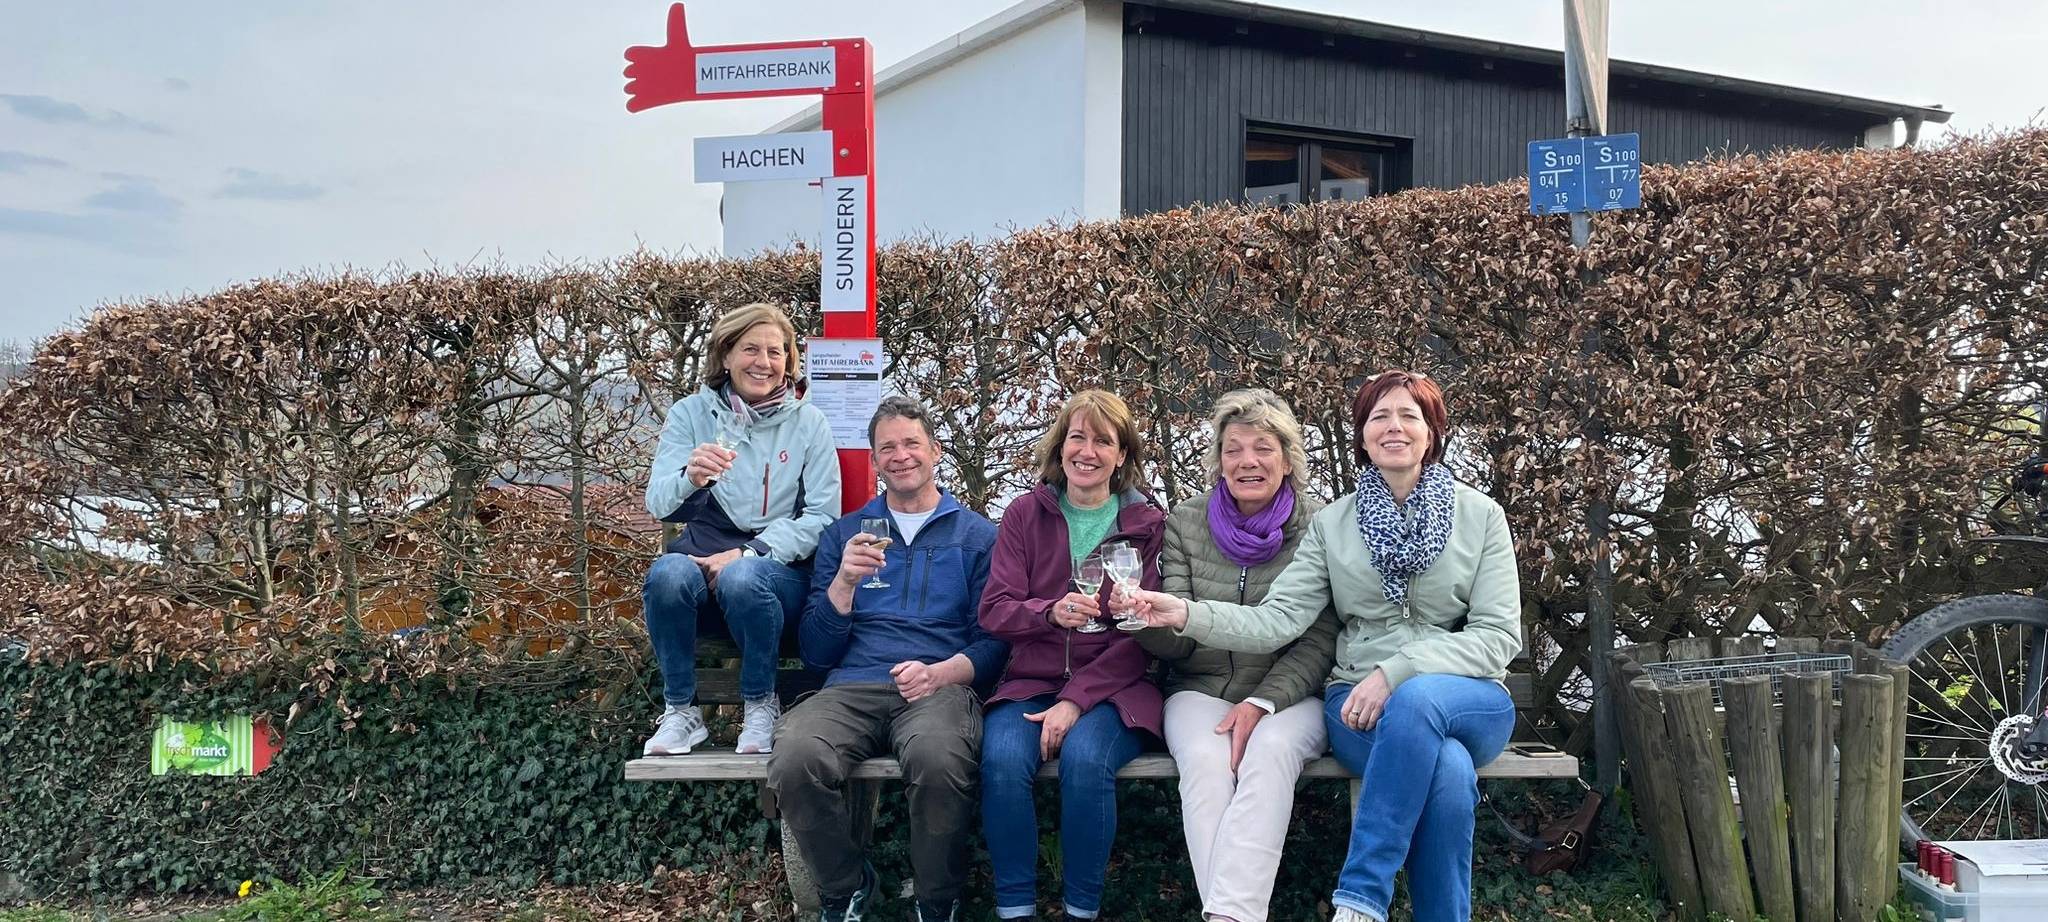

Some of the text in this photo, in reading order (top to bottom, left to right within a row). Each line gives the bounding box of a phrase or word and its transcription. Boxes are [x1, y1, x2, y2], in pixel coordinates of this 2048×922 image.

[701, 60, 831, 81] MITFAHRERBANK
[722, 147, 805, 169] HACHEN
[836, 187, 855, 291] SUNDERN
